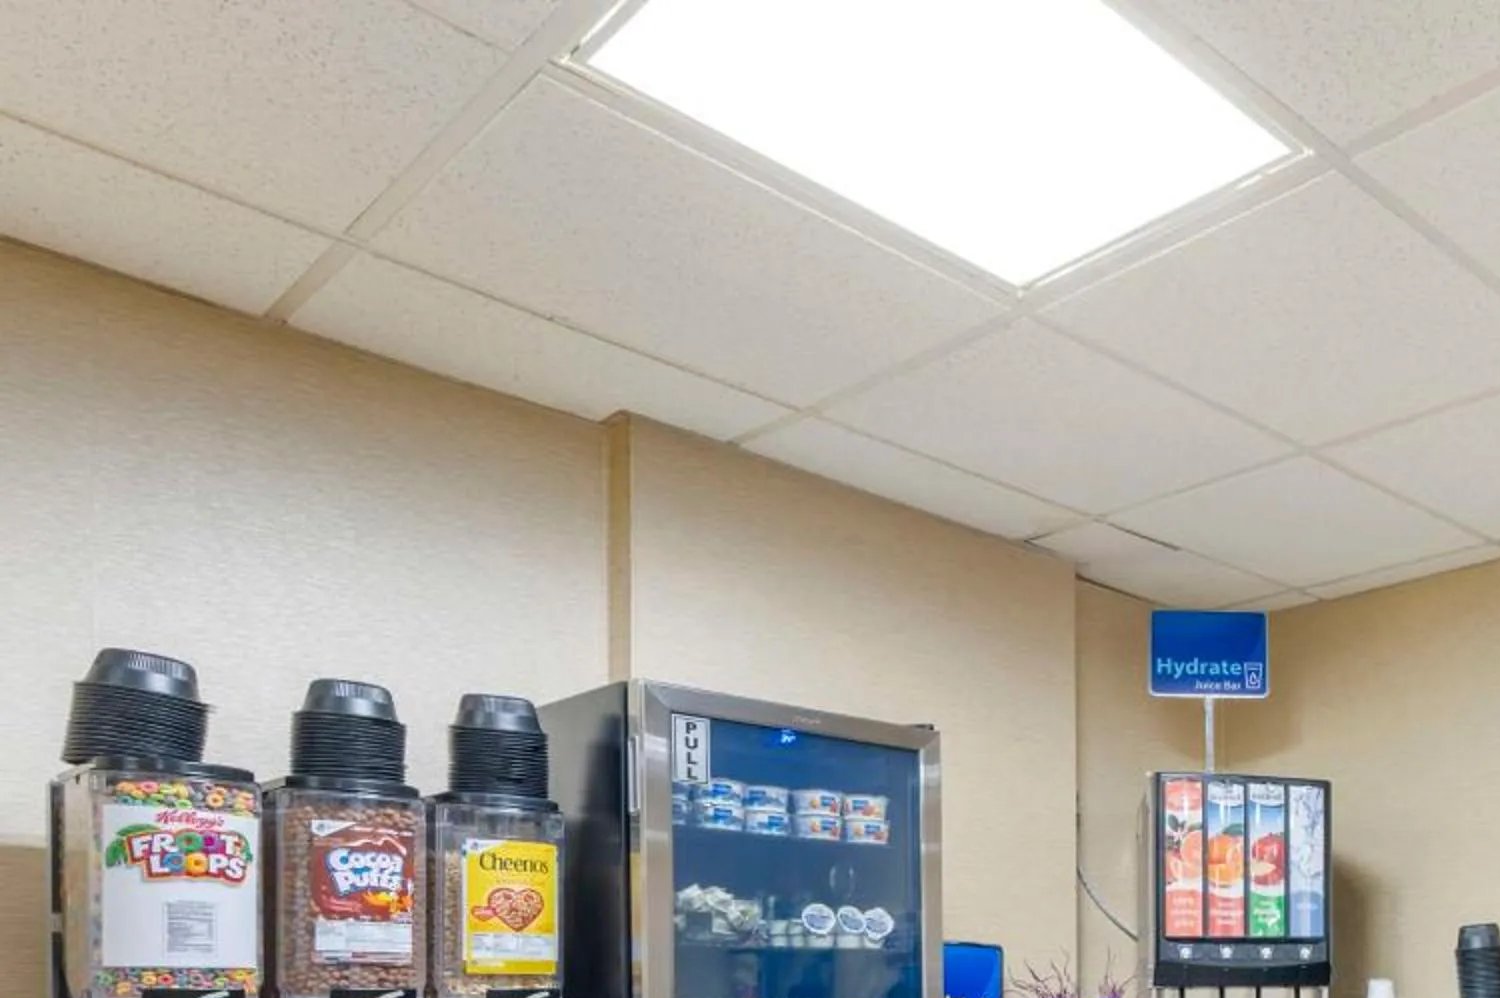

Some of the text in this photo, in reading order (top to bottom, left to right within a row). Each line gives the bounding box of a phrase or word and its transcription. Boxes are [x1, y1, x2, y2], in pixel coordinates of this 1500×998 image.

[1156, 657, 1242, 679] Hydrate
[685, 721, 699, 780] PULL
[131, 832, 241, 858] FROOT
[150, 851, 246, 880] LOOPS
